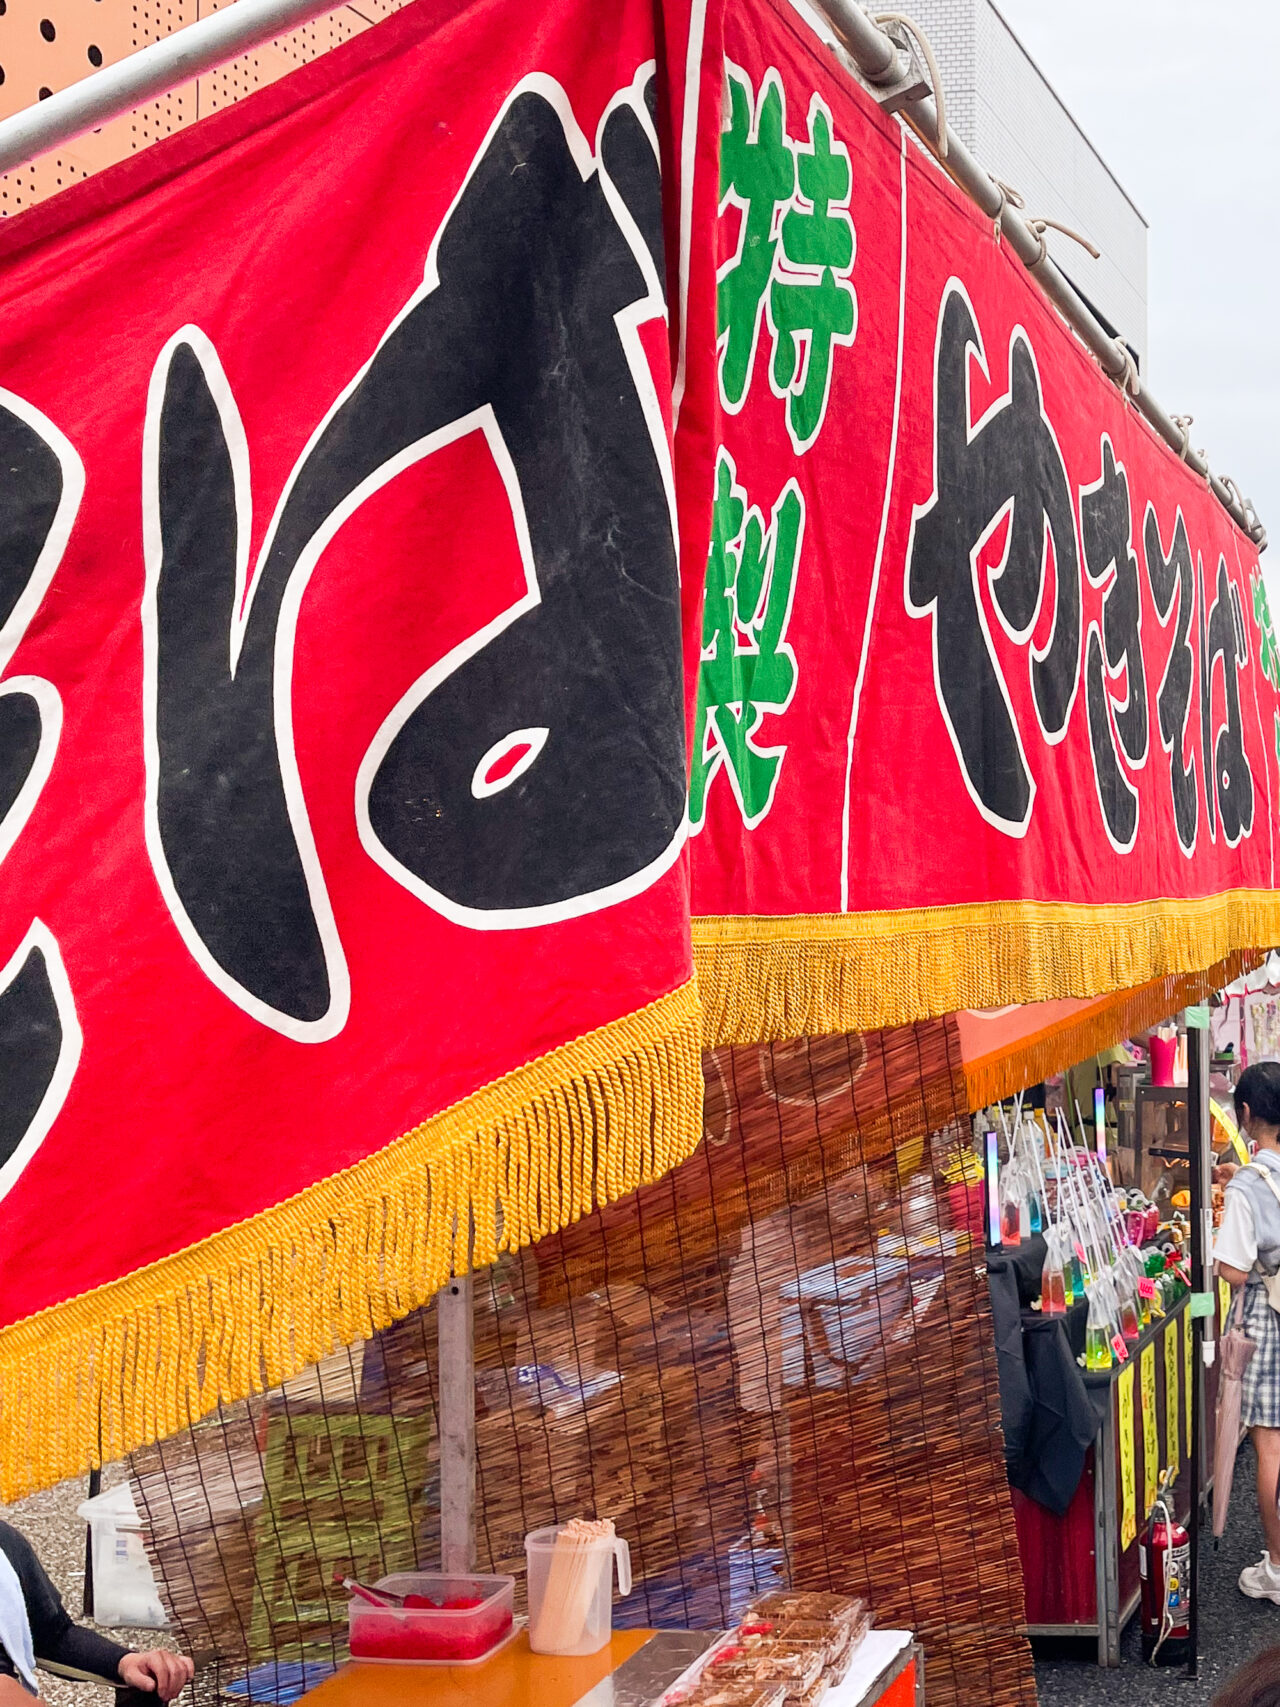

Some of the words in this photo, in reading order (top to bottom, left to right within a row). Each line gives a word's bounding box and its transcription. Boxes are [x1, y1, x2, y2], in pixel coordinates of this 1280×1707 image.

[688, 53, 858, 831] 特製
[905, 275, 1255, 858] やきそば
